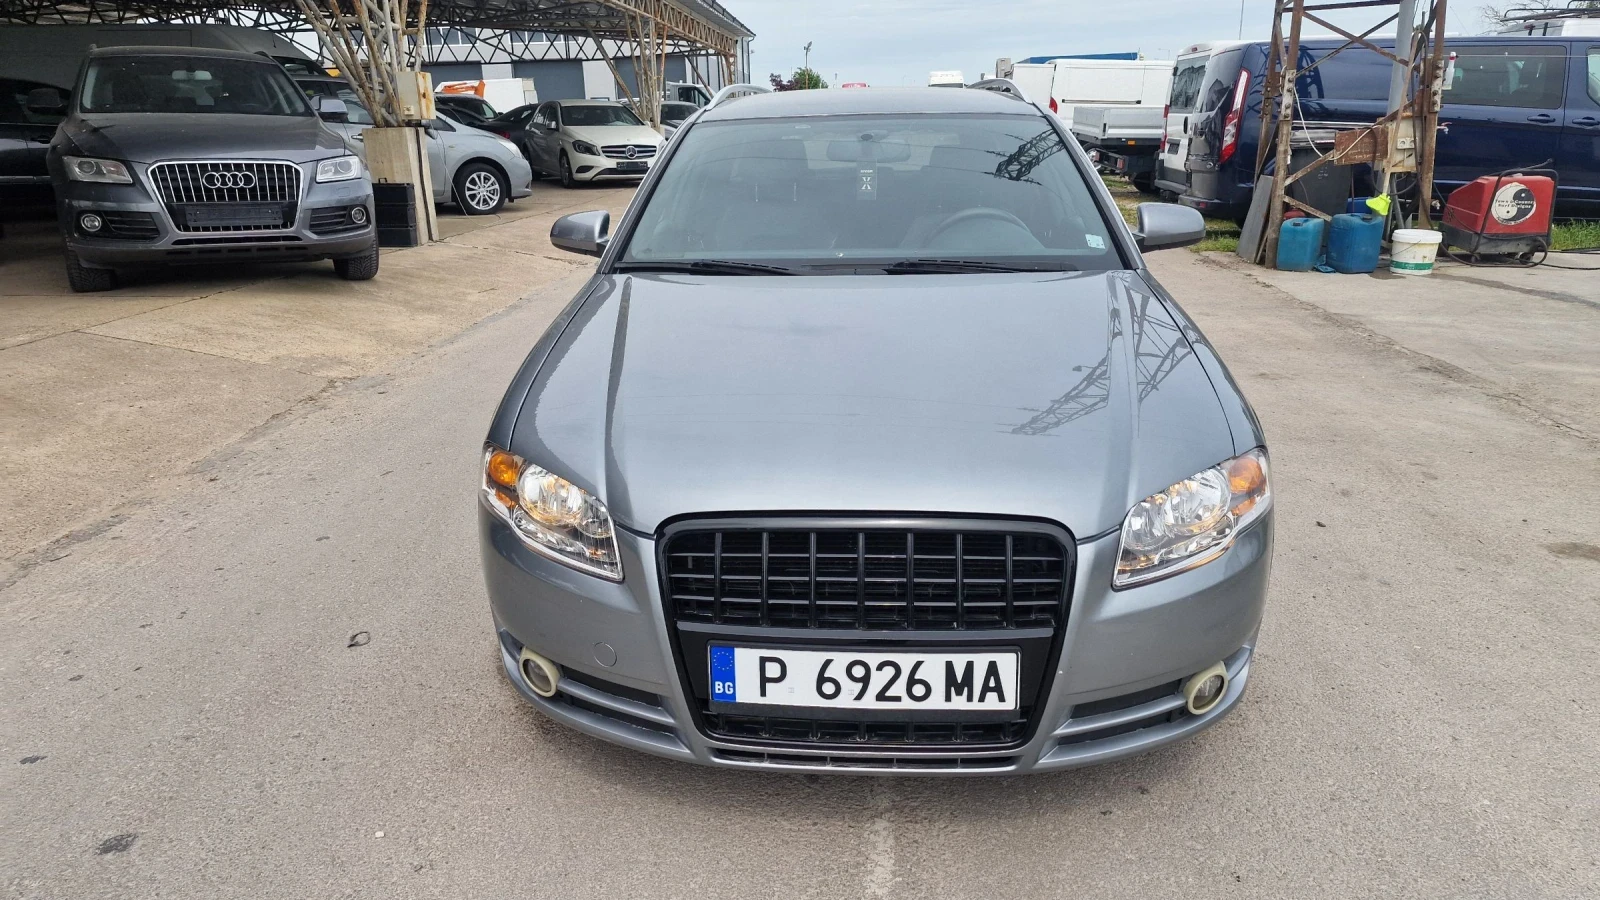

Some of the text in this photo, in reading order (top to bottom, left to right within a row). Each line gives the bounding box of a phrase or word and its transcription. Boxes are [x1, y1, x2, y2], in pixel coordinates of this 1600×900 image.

[714, 681, 734, 695] BG
[759, 655, 1006, 703] P 6926 MA
